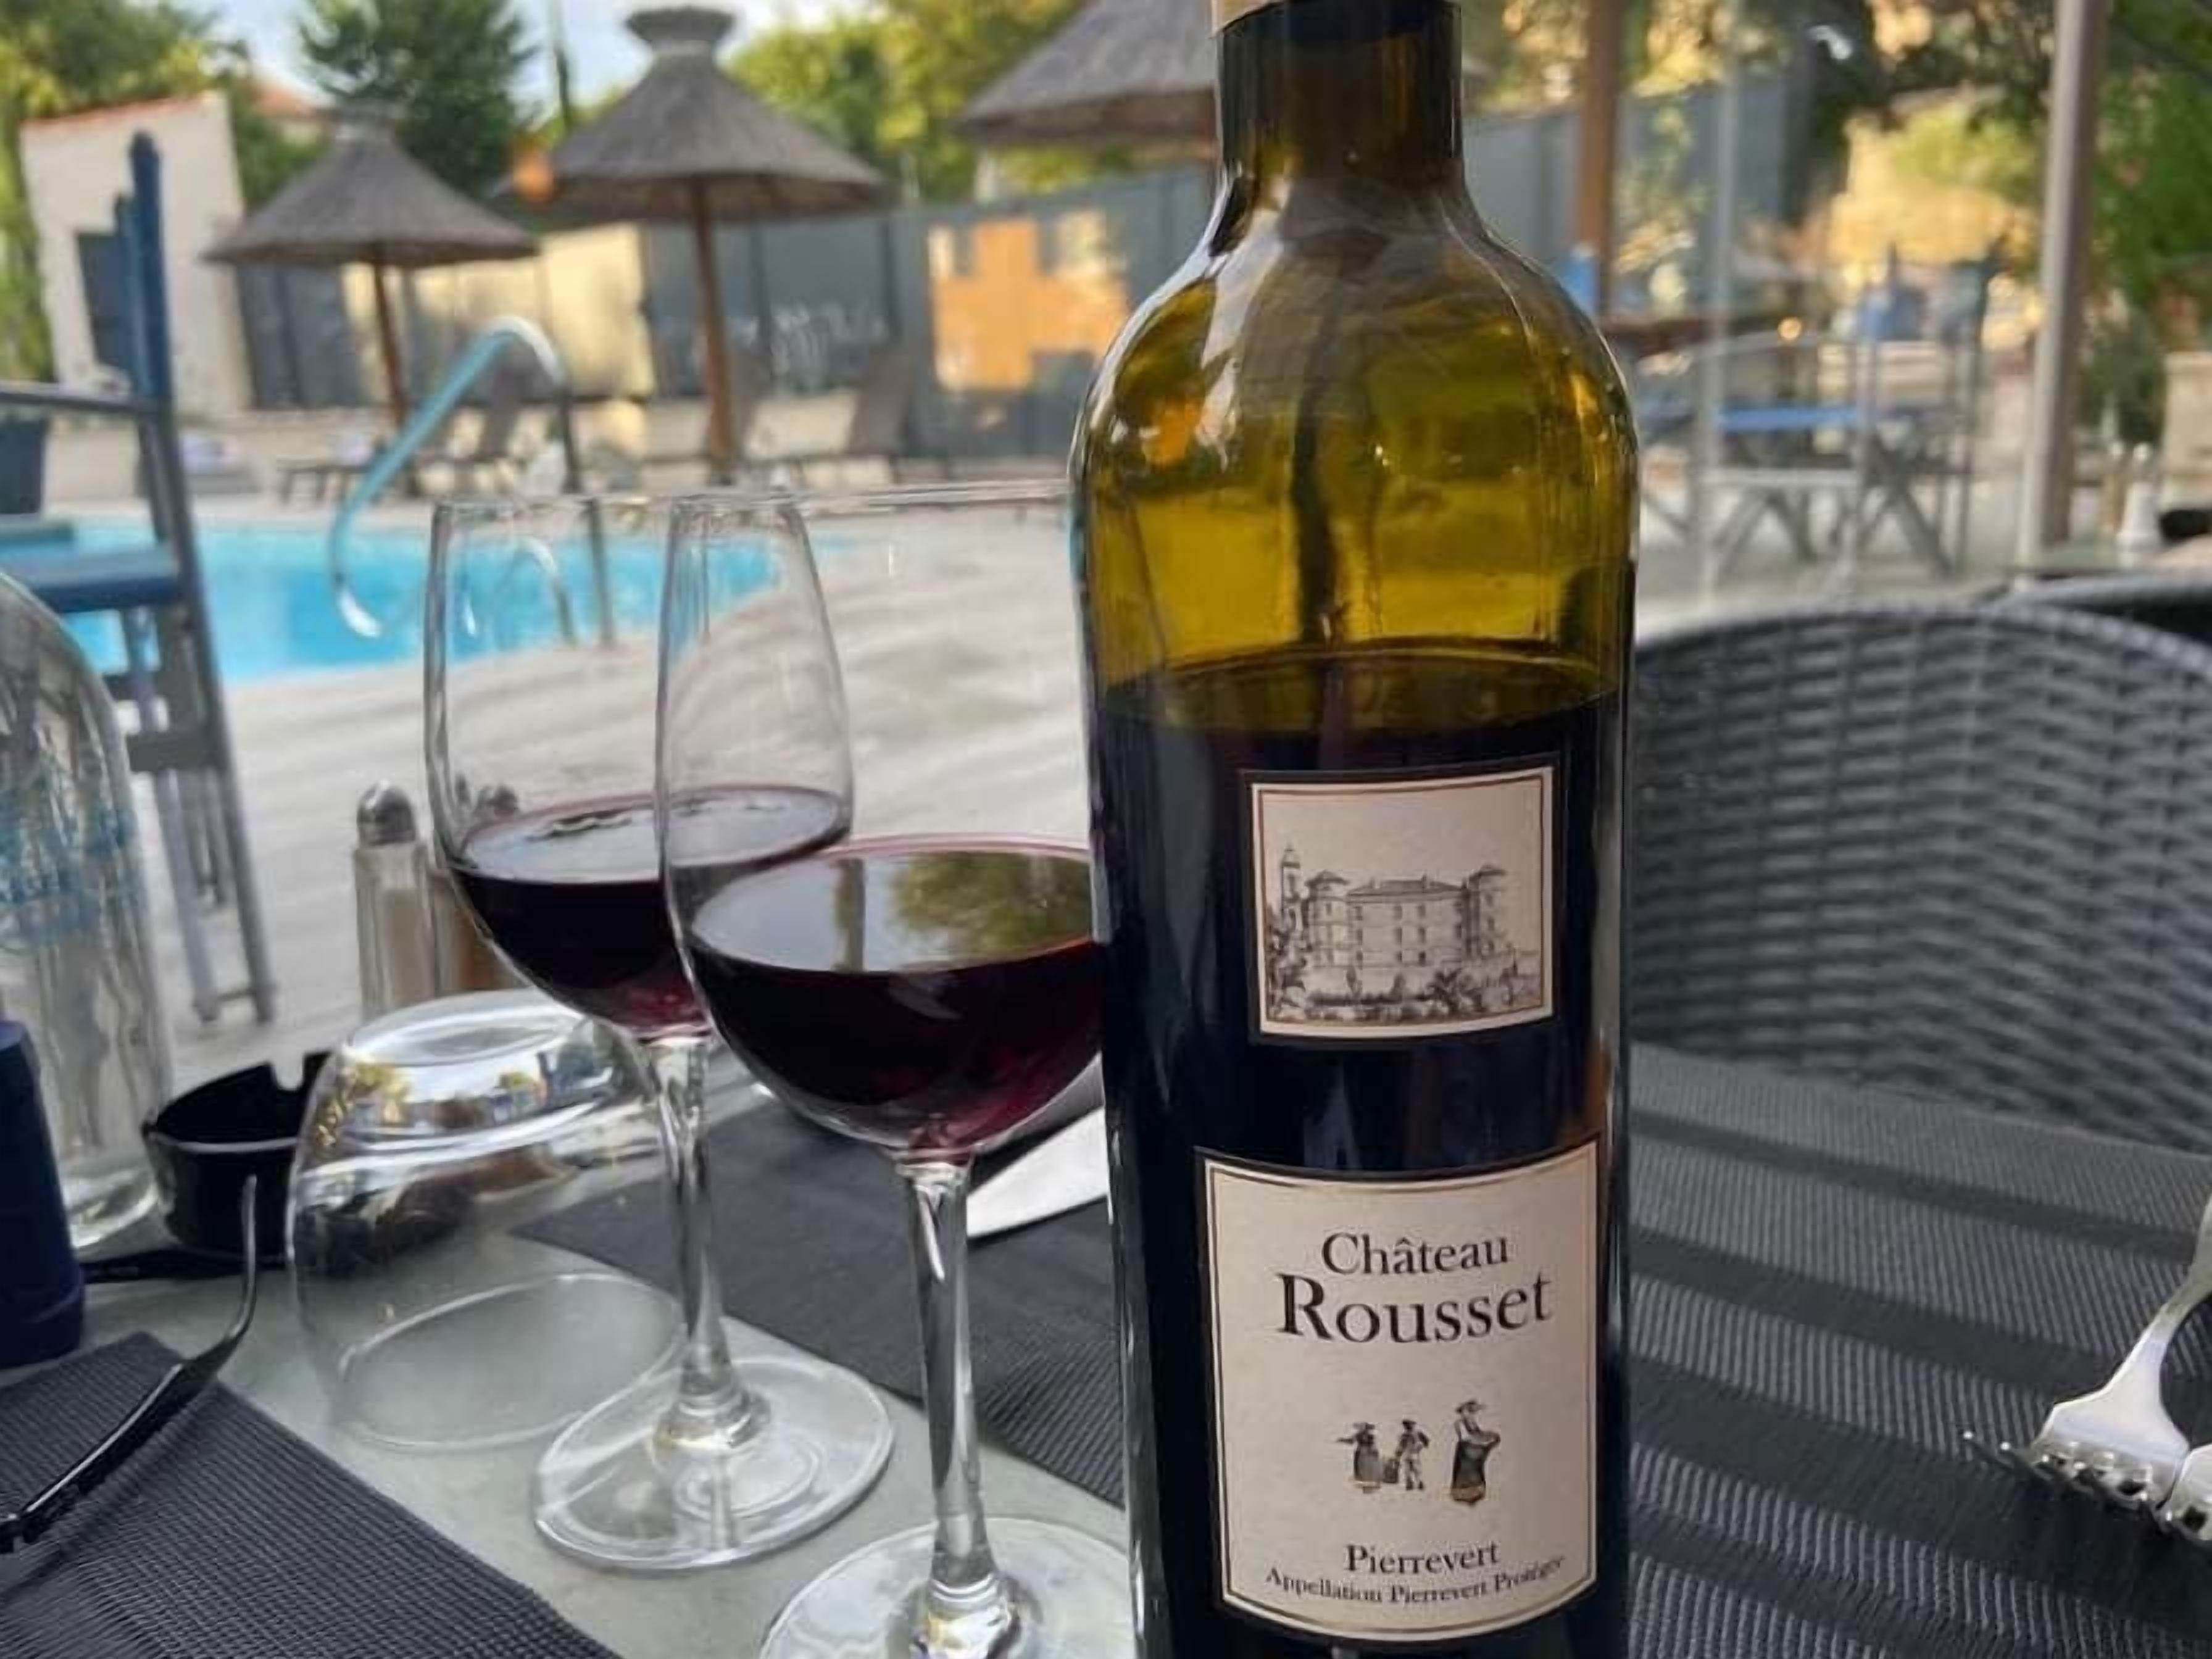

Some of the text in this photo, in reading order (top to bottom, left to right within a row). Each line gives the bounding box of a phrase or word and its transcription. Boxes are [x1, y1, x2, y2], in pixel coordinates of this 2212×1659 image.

[1321, 1232, 1508, 1274] Château
[1276, 1271, 1552, 1343] Rousset
[1344, 1543, 1499, 1573] Pierrevert
[1266, 1566, 1382, 1603] Appellation
